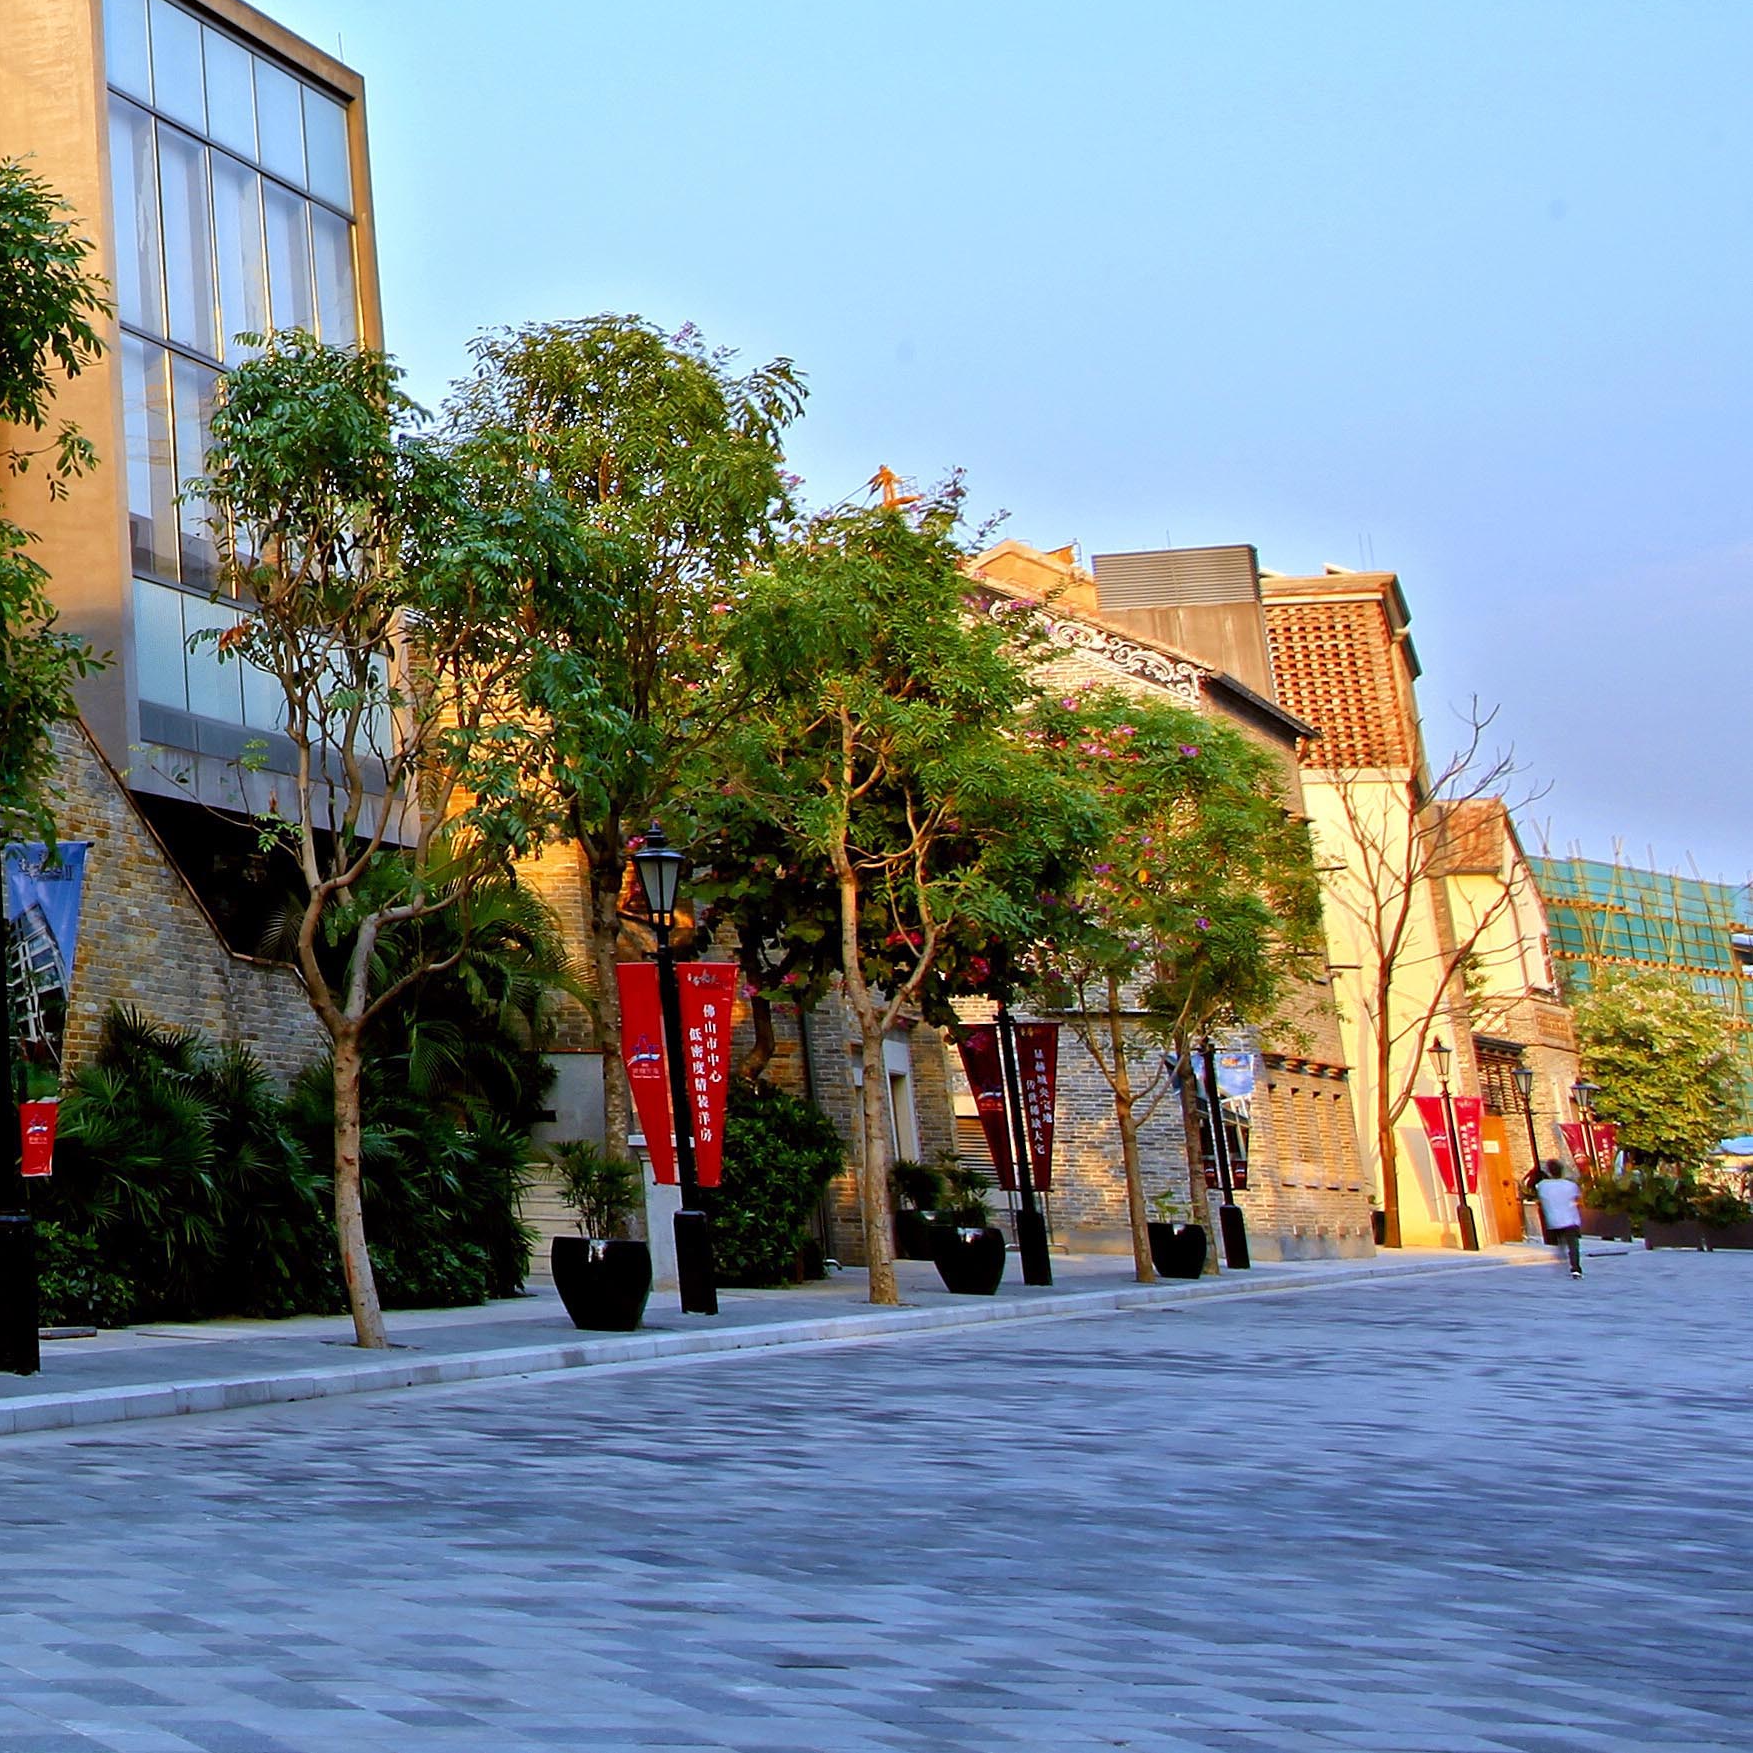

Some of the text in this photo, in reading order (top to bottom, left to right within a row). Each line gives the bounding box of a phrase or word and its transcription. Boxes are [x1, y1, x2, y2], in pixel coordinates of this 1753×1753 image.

[688, 1026, 713, 1143] 低密度精装洋房
[702, 1003, 722, 1084] 佛山市中心
